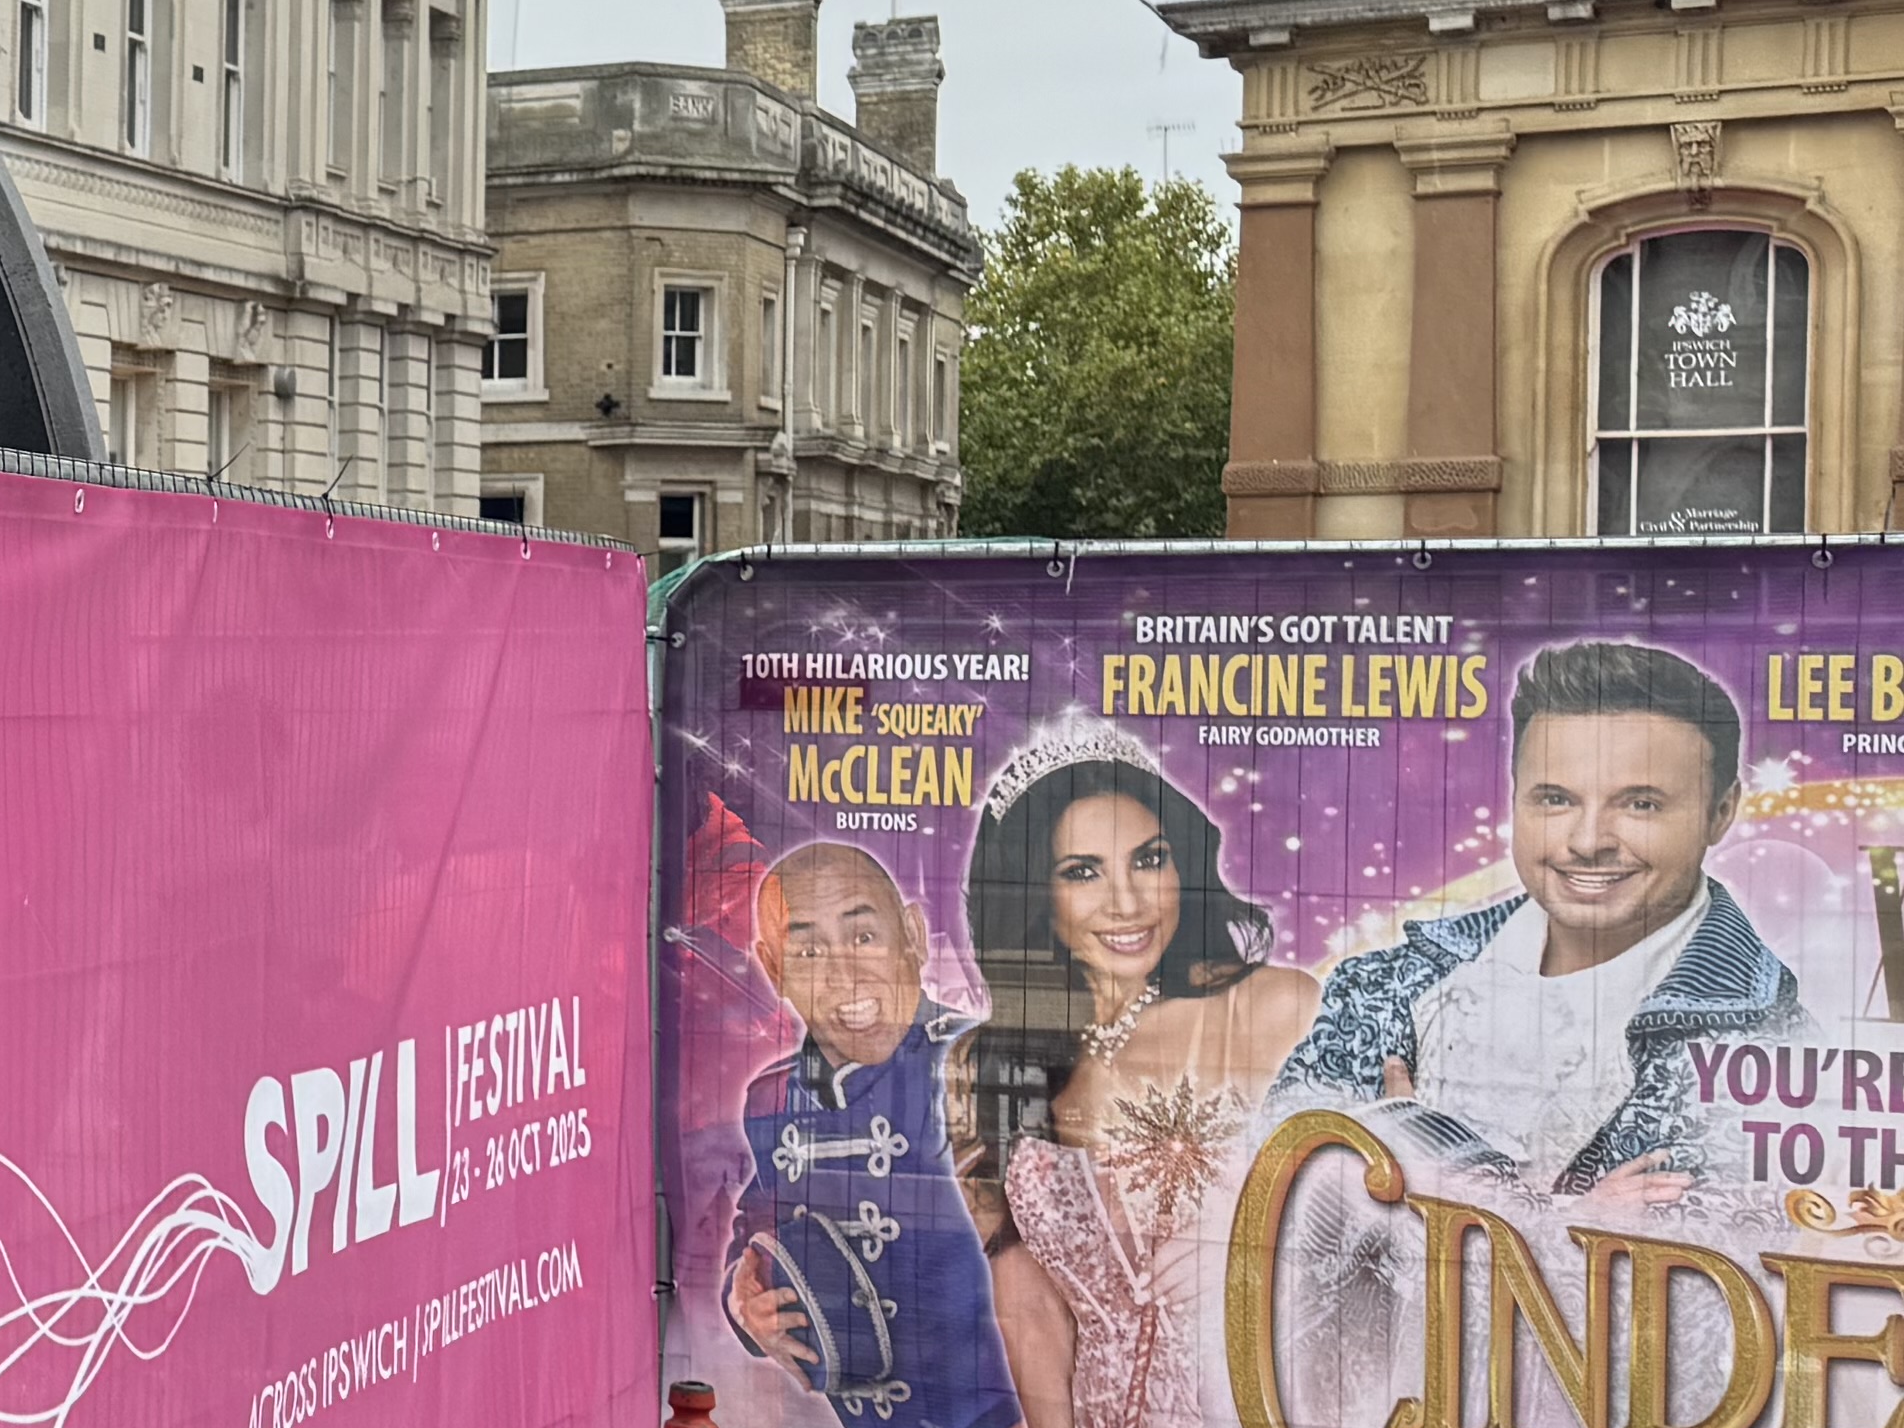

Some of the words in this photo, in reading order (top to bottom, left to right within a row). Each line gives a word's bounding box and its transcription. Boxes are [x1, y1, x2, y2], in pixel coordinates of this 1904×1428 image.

[1664, 351, 1738, 370] TOWN
[1673, 339, 1731, 352] IPSWICH
[1669, 370, 1733, 387] HALL
[1136, 615, 1275, 644] BRITAIN'S
[1279, 615, 1339, 644] GOT
[1342, 615, 1454, 645] TALENT
[741, 652, 800, 679] 10TH
[805, 652, 949, 681] HILARIOUS
[952, 653, 1031, 681] YEAR!
[1101, 653, 1328, 718] FRANCINE
[1340, 653, 1489, 719] LEWIS
[1767, 653, 1857, 722] LEE
[783, 685, 865, 735] MIKE
[870, 702, 984, 739] 'SQUEAKY'
[1198, 725, 1253, 746] FAIRY
[1255, 726, 1381, 748] GODMOTHER
[787, 743, 974, 808] McCLEAN
[835, 812, 919, 832] BUTTONS
[243, 1037, 441, 1297] SPILL
[454, 994, 587, 1128] FESTIVAL
[449, 1147, 471, 1206] 23
[485, 1136, 507, 1192] 26
[507, 1115, 542, 1181] OCT
[547, 1107, 592, 1171] 2025
[1741, 1120, 1826, 1186] TO
[322, 1315, 409, 1410] IPSWICH
[421, 1237, 583, 1358] SPILLFESTIVAL.COM
